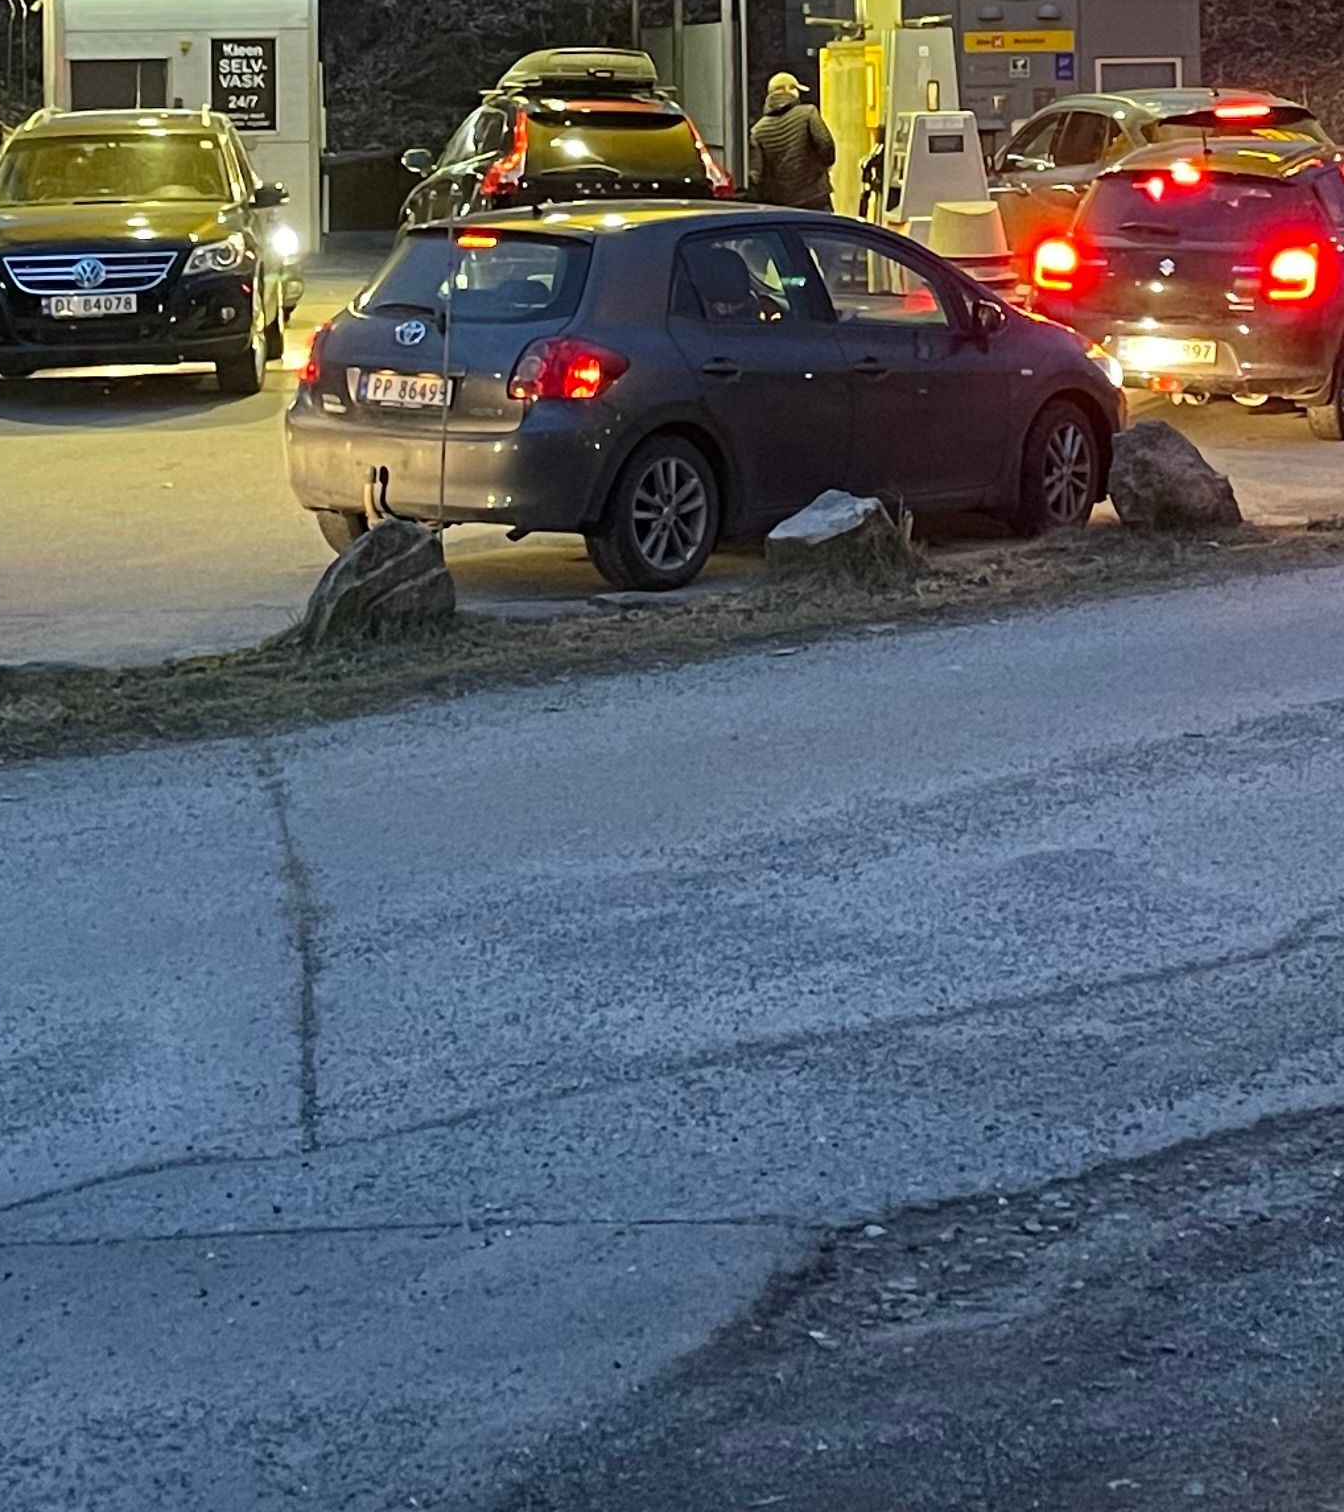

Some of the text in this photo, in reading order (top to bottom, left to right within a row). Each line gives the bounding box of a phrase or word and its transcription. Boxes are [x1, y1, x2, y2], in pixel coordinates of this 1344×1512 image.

[222, 43, 263, 56] Kleen
[219, 58, 268, 73] SELV-
[218, 74, 265, 88] VASK
[228, 94, 258, 109] 24/7
[83, 297, 133, 312] 84078
[373, 377, 393, 397] PP
